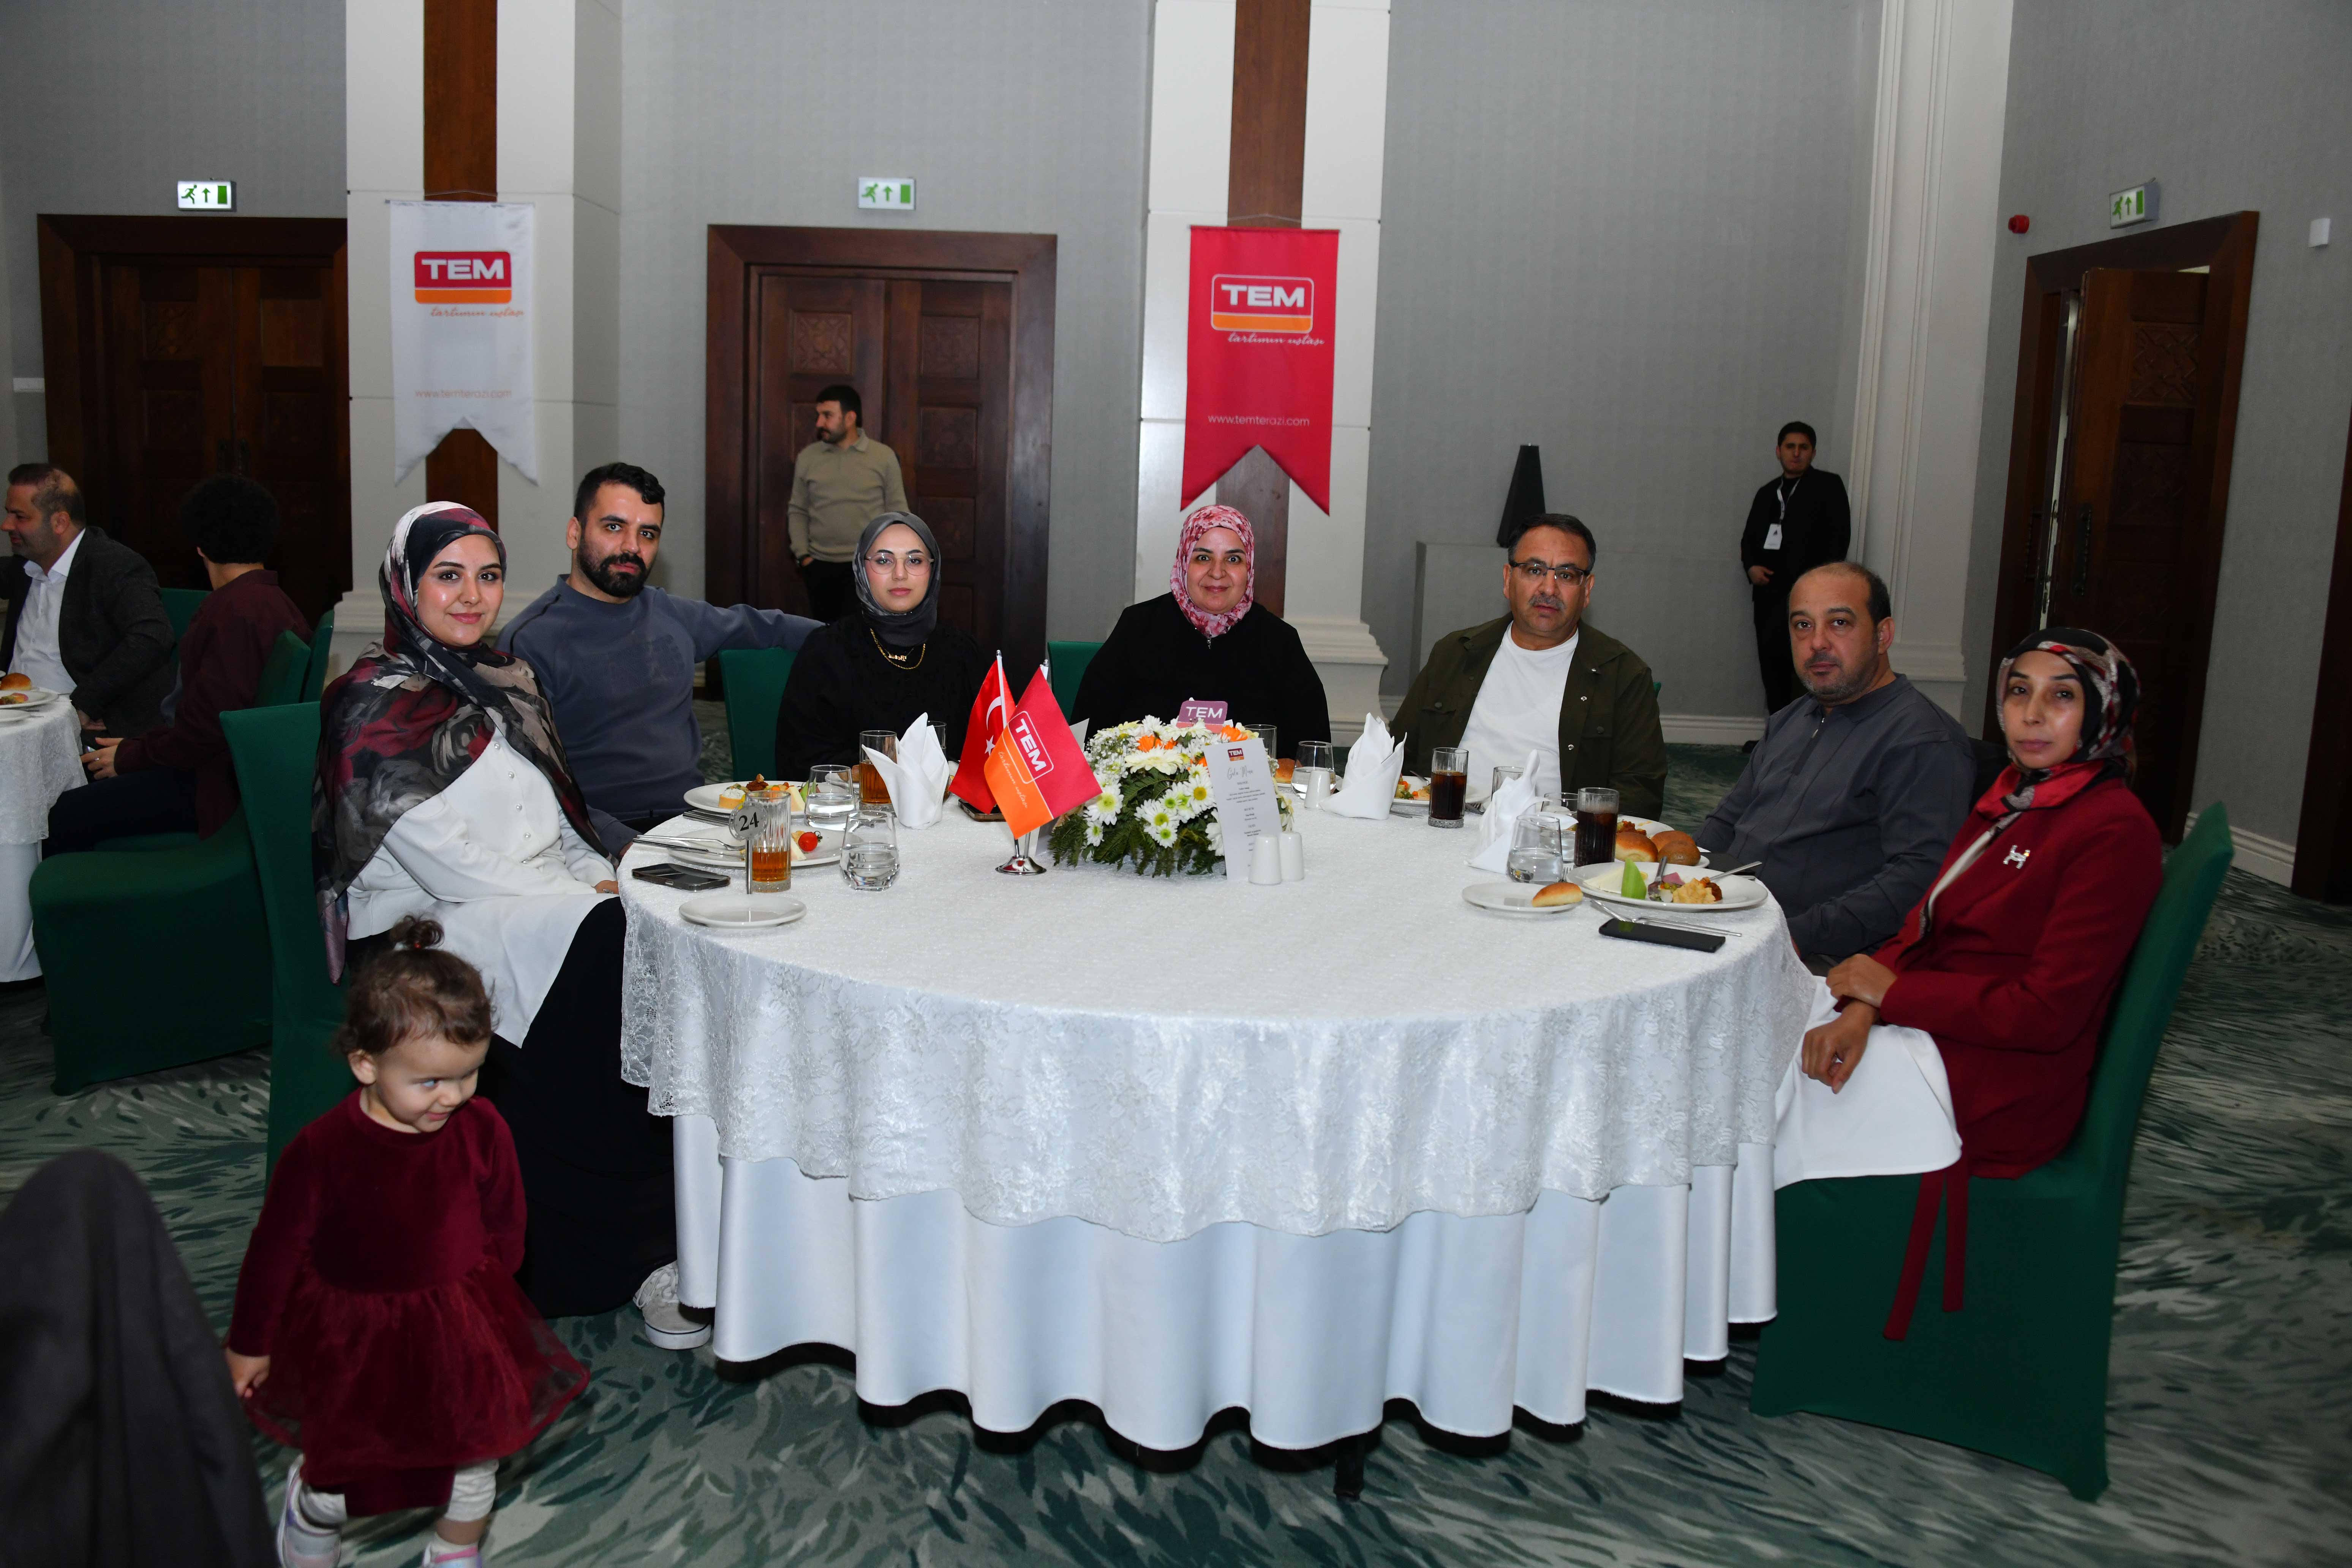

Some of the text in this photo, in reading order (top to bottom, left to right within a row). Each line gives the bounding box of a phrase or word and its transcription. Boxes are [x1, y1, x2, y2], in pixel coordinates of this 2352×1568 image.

[422, 259, 504, 280] TEM
[1221, 284, 1305, 308] TEM
[415, 389, 512, 399] www.temterazi.com
[1208, 415, 1310, 426] www.temterazi.com
[1186, 707, 1223, 718] TEM
[1015, 718, 1046, 771] TEM
[739, 812, 759, 831] 24
